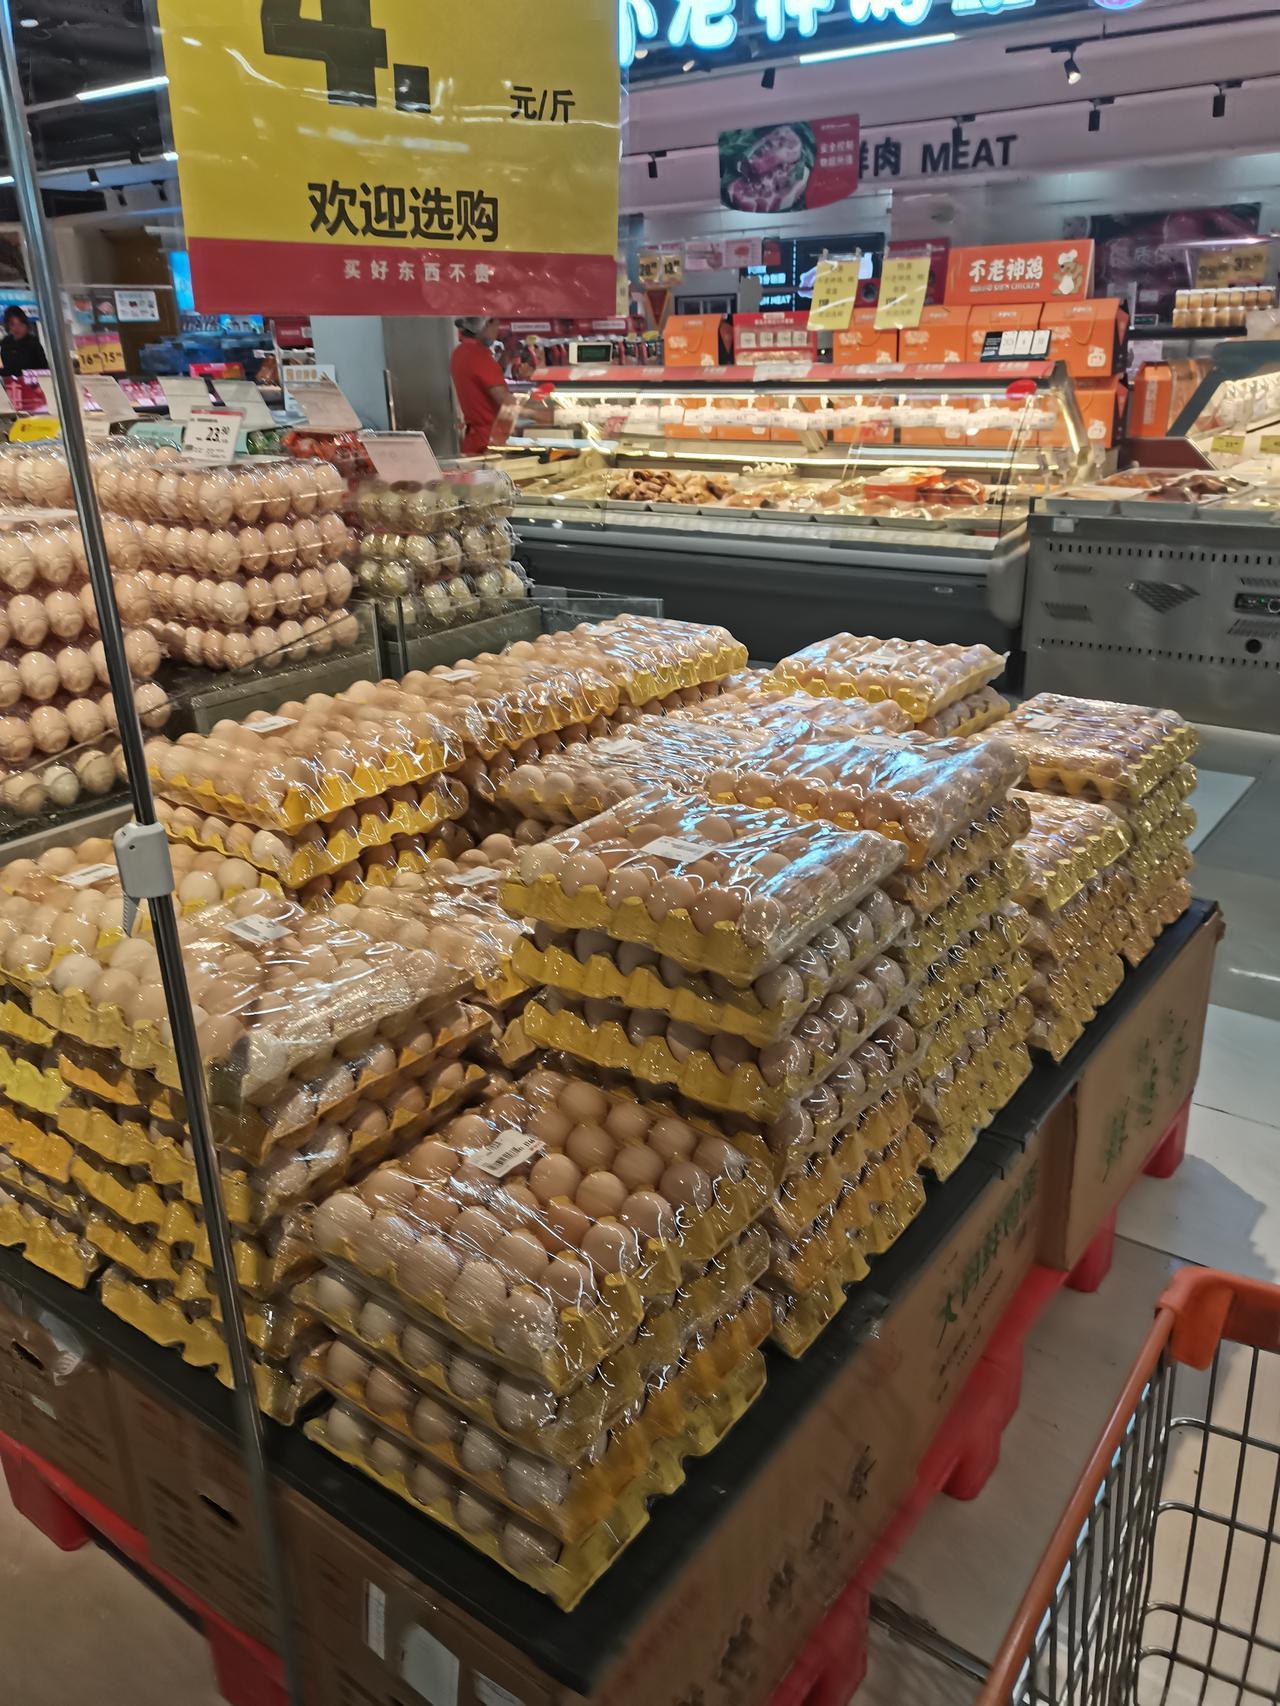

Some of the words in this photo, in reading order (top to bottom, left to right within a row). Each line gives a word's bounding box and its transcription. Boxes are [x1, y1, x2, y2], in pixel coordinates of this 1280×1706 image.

[510, 86, 575, 122] 元/斤
[921, 135, 1018, 173] MEAT
[307, 180, 499, 242] 欢迎选购
[343, 259, 493, 283] 买好东西不贵
[969, 256, 1043, 283] 不老神鸡
